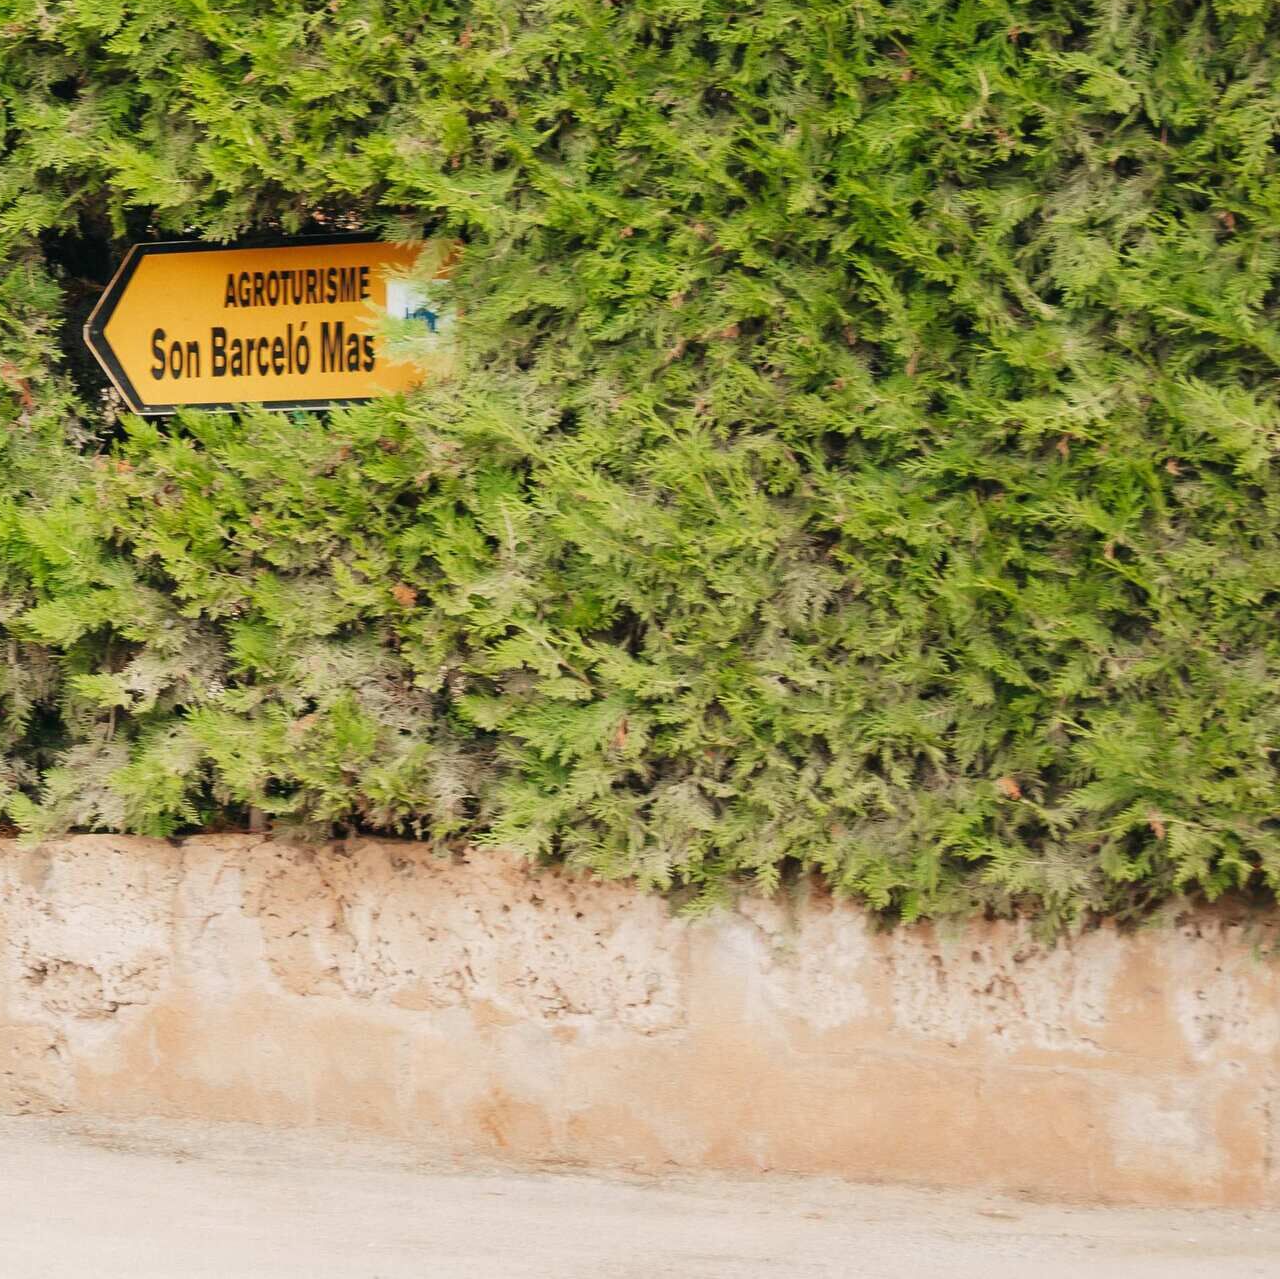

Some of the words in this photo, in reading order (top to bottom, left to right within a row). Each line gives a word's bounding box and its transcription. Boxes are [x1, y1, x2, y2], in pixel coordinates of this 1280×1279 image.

[224, 266, 371, 308] AGROTURISME
[150, 327, 200, 380] Son
[211, 320, 309, 377] Barceló
[320, 321, 375, 373] Mas
